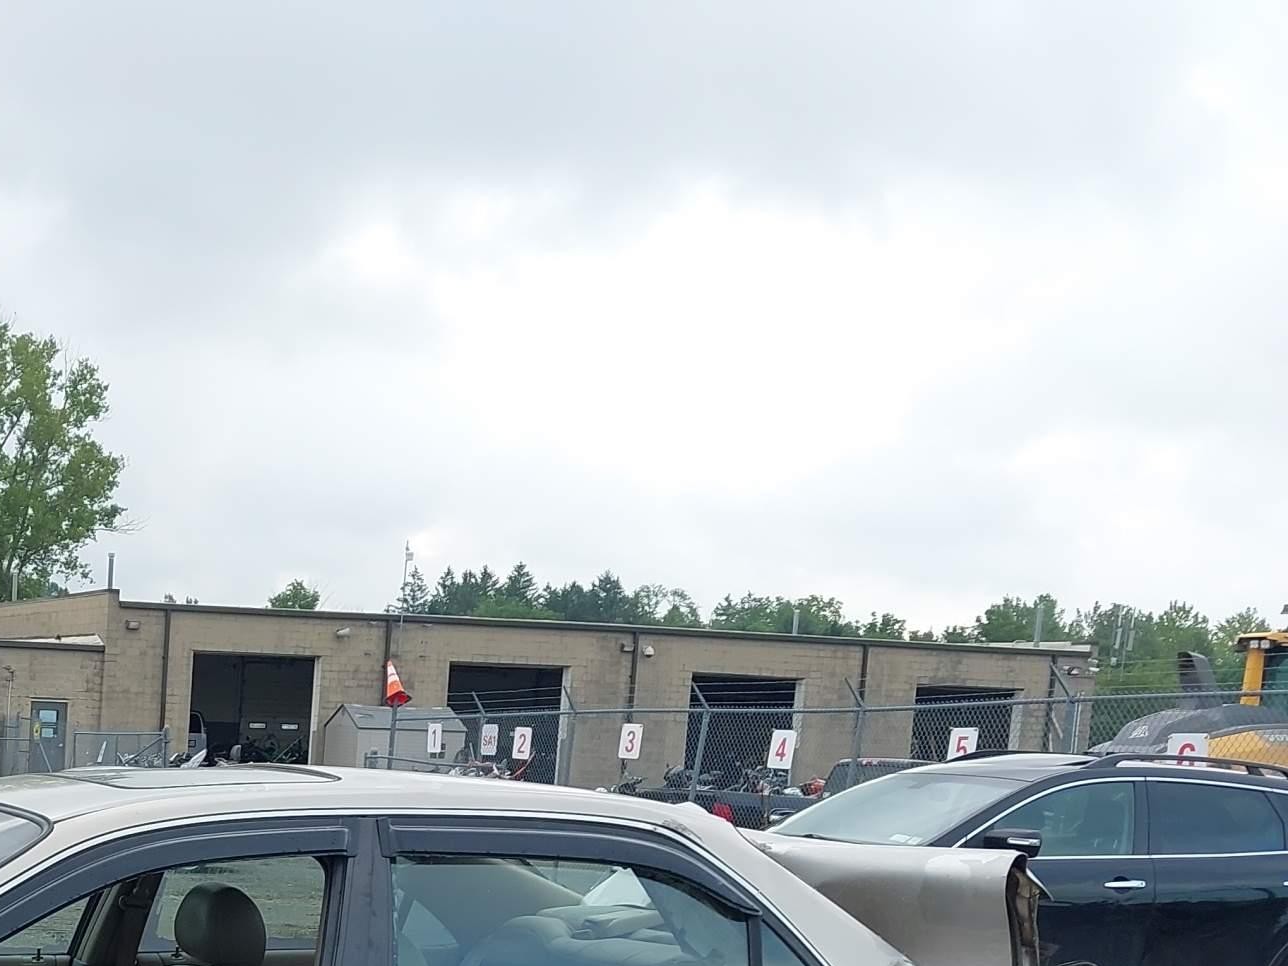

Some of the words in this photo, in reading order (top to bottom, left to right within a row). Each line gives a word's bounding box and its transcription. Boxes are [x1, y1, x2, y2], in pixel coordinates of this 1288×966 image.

[431, 728, 438, 748] 1
[517, 733, 527, 754] 2
[624, 730, 636, 753] 3
[955, 736, 969, 755] 5
[775, 737, 787, 762] 4
